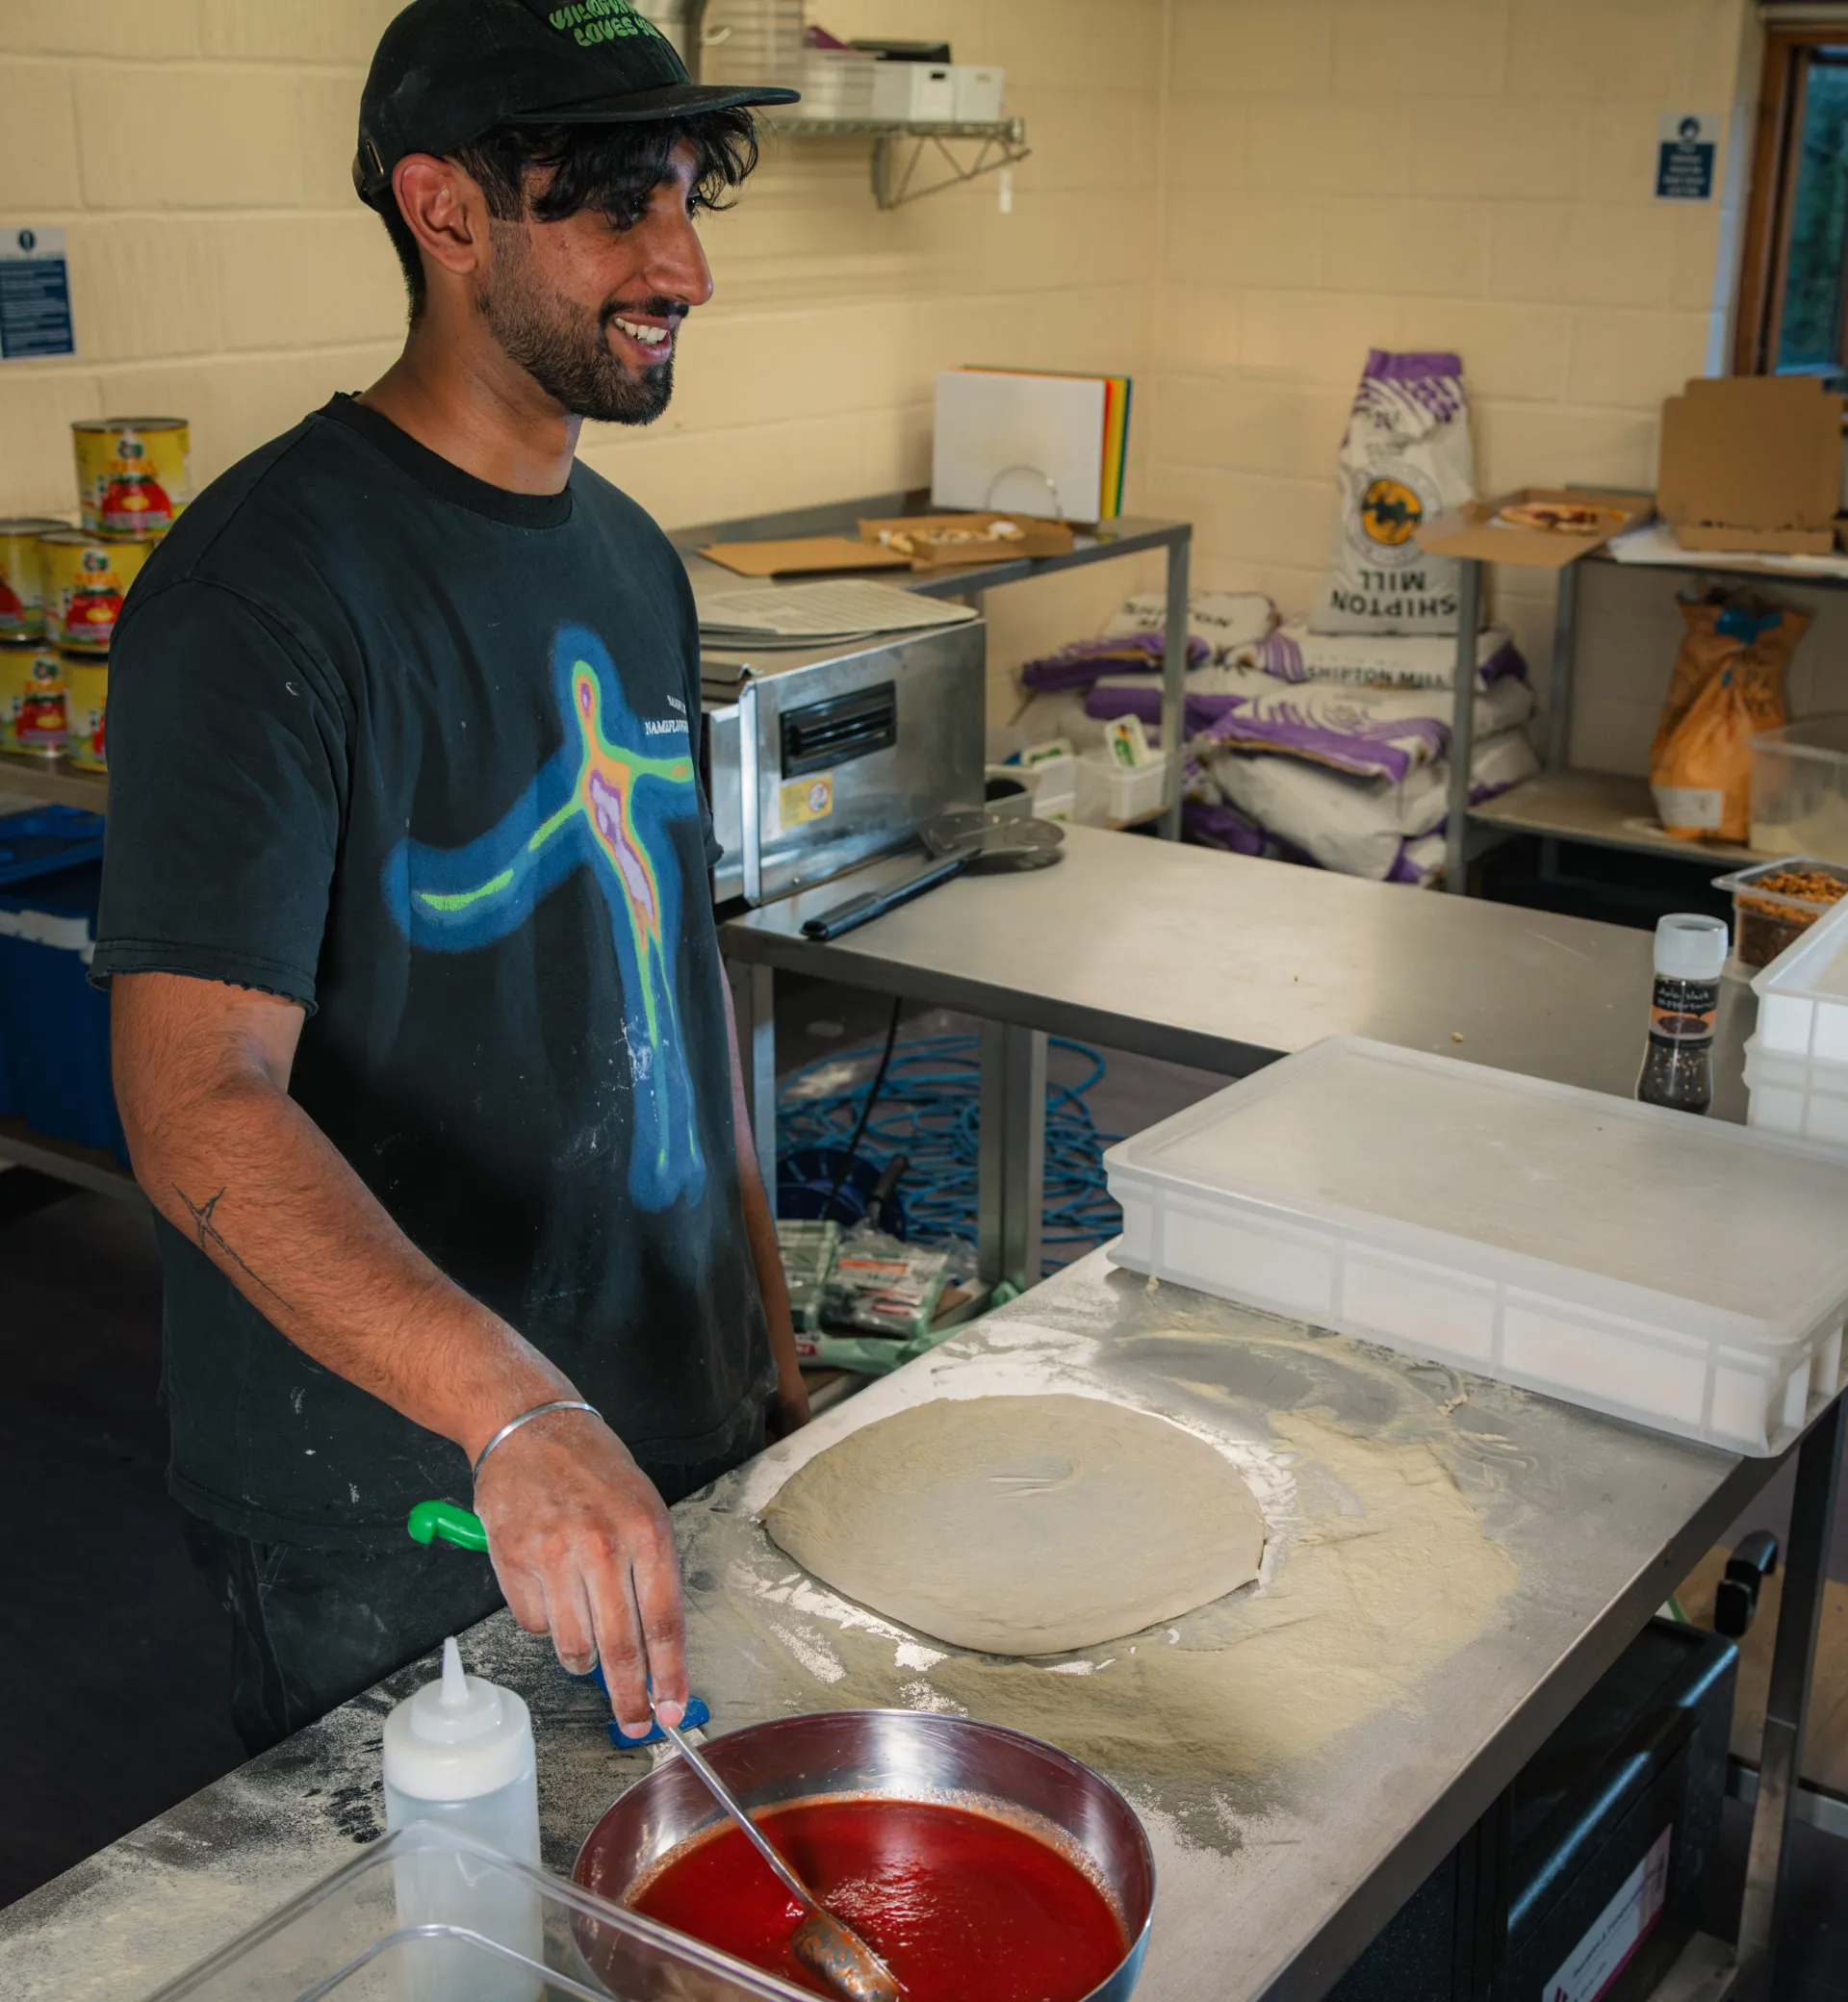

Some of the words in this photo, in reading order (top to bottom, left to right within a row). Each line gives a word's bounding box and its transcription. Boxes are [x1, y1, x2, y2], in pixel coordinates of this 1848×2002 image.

[574, 16, 638, 47] LOVES
[1358, 571, 1426, 592] MILL
[1330, 589, 1458, 617] SHIPTON
[1308, 664, 1394, 686] SHIPTON
